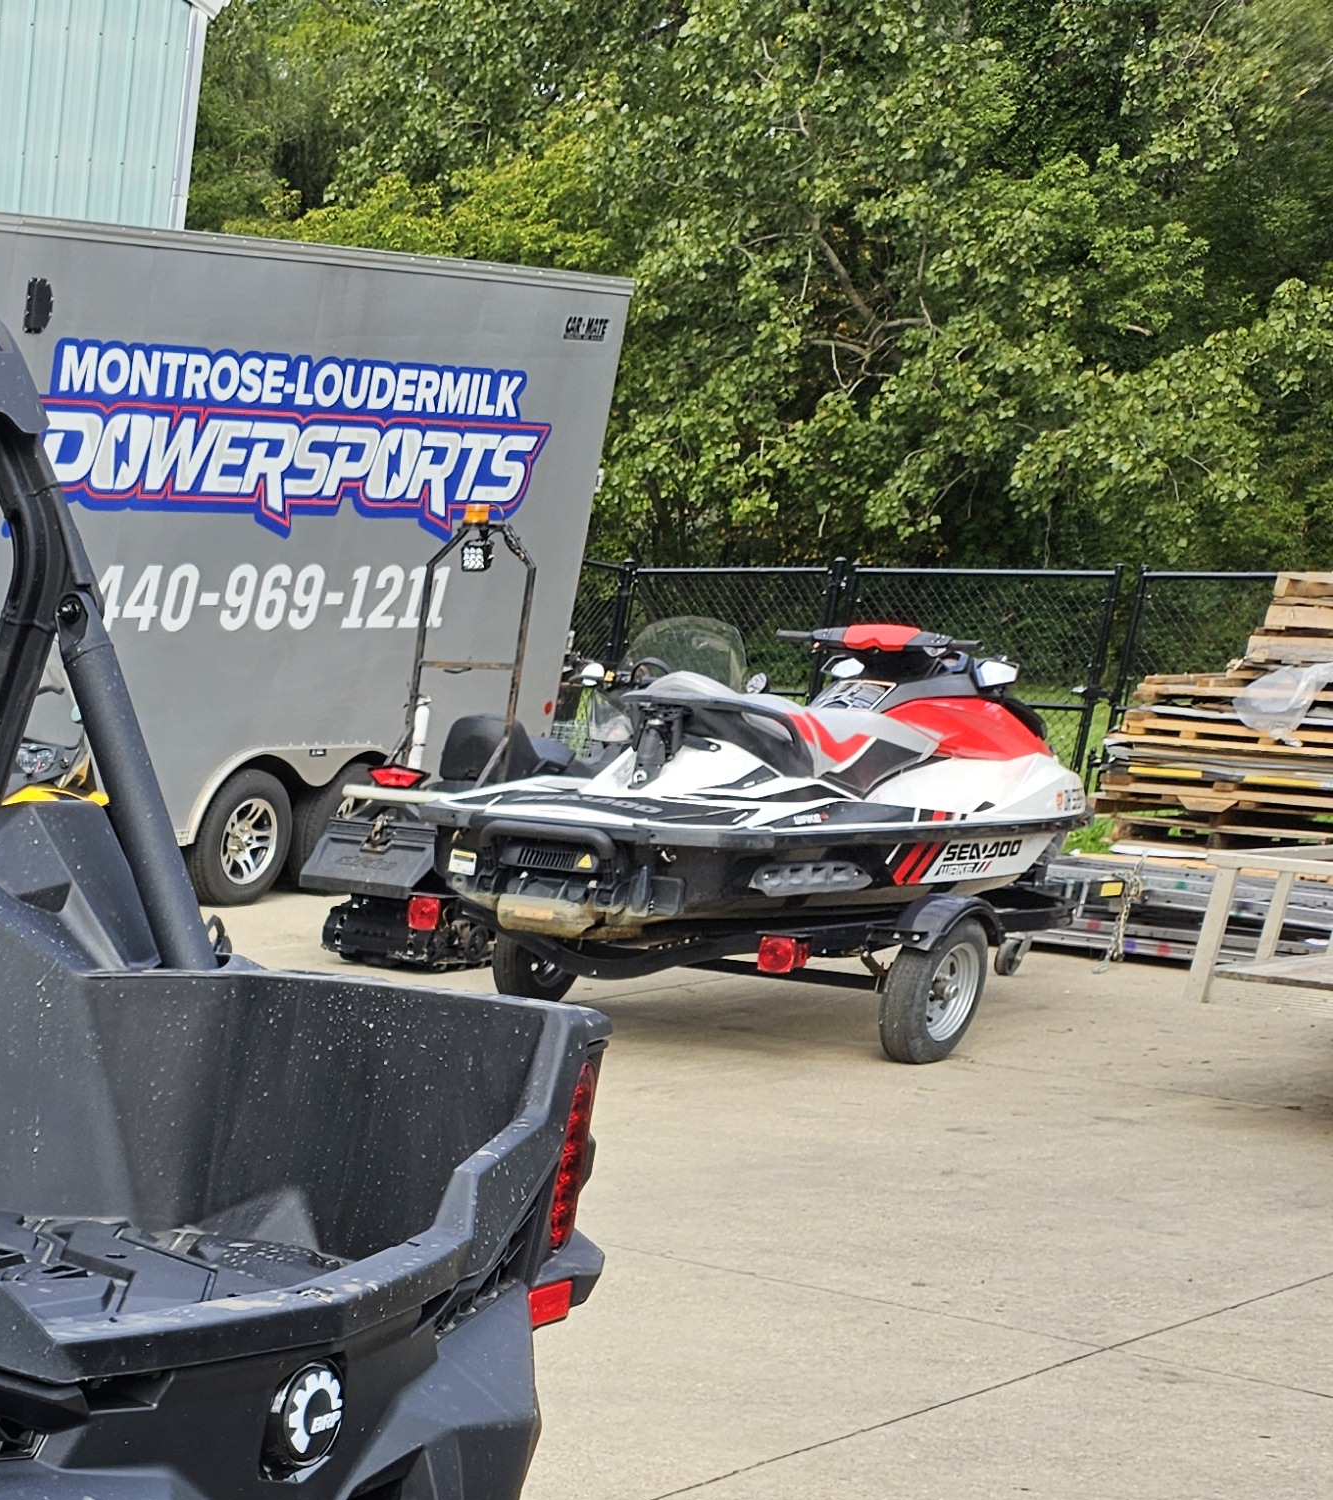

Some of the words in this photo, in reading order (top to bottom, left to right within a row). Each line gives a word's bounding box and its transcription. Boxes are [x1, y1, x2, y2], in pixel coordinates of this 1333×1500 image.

[59, 345, 523, 418] MONTROSE-LOUDERMILK
[43, 410, 538, 519] POWERSPORTS
[97, 562, 451, 632] 440-969-1211
[309, 1410, 342, 1435] BRP
